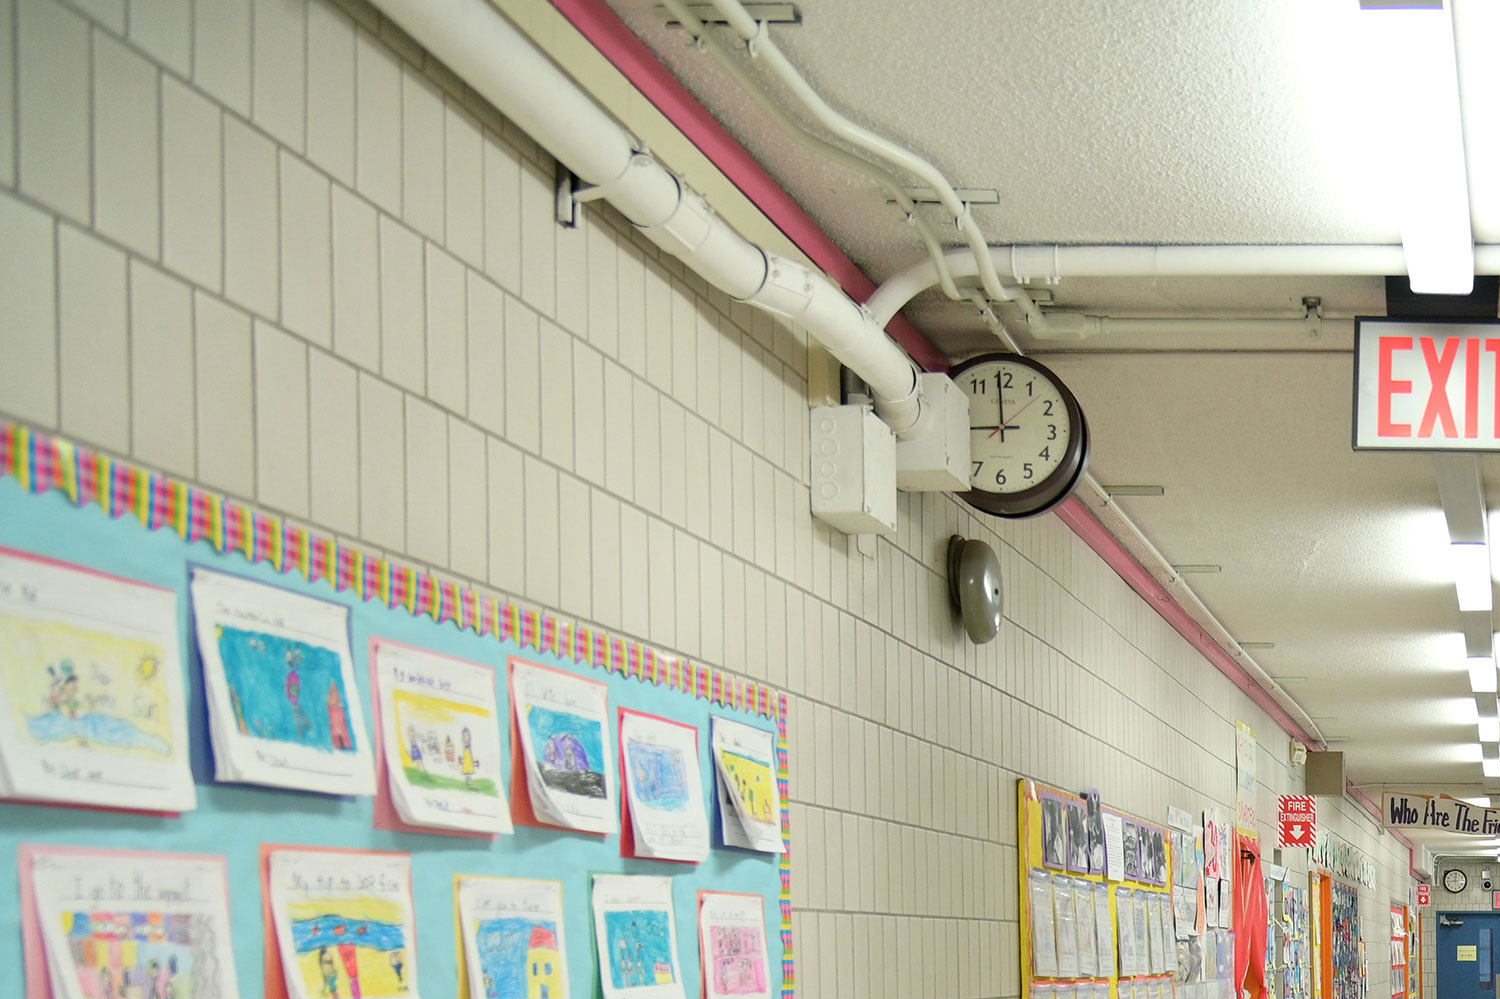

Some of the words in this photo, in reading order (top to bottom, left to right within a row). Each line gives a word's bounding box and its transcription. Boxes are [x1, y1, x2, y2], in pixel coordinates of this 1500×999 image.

[970, 379, 986, 395] 11
[994, 370, 1014, 389] 12
[1026, 381, 1033, 397] 1
[1043, 400, 1054, 416] 2
[1047, 424, 1057, 440] 3
[1039, 446, 1050, 461] 4
[972, 461, 984, 477] 7
[995, 469, 1007, 485] 6
[1024, 463, 1034, 479] 5
[1288, 801, 1307, 811] FIRE
[1280, 812, 1314, 822] EXTINGUISHER
[1390, 797, 1419, 825] Who
[1423, 799, 1450, 827] Are
[1455, 802, 1480, 833] The
